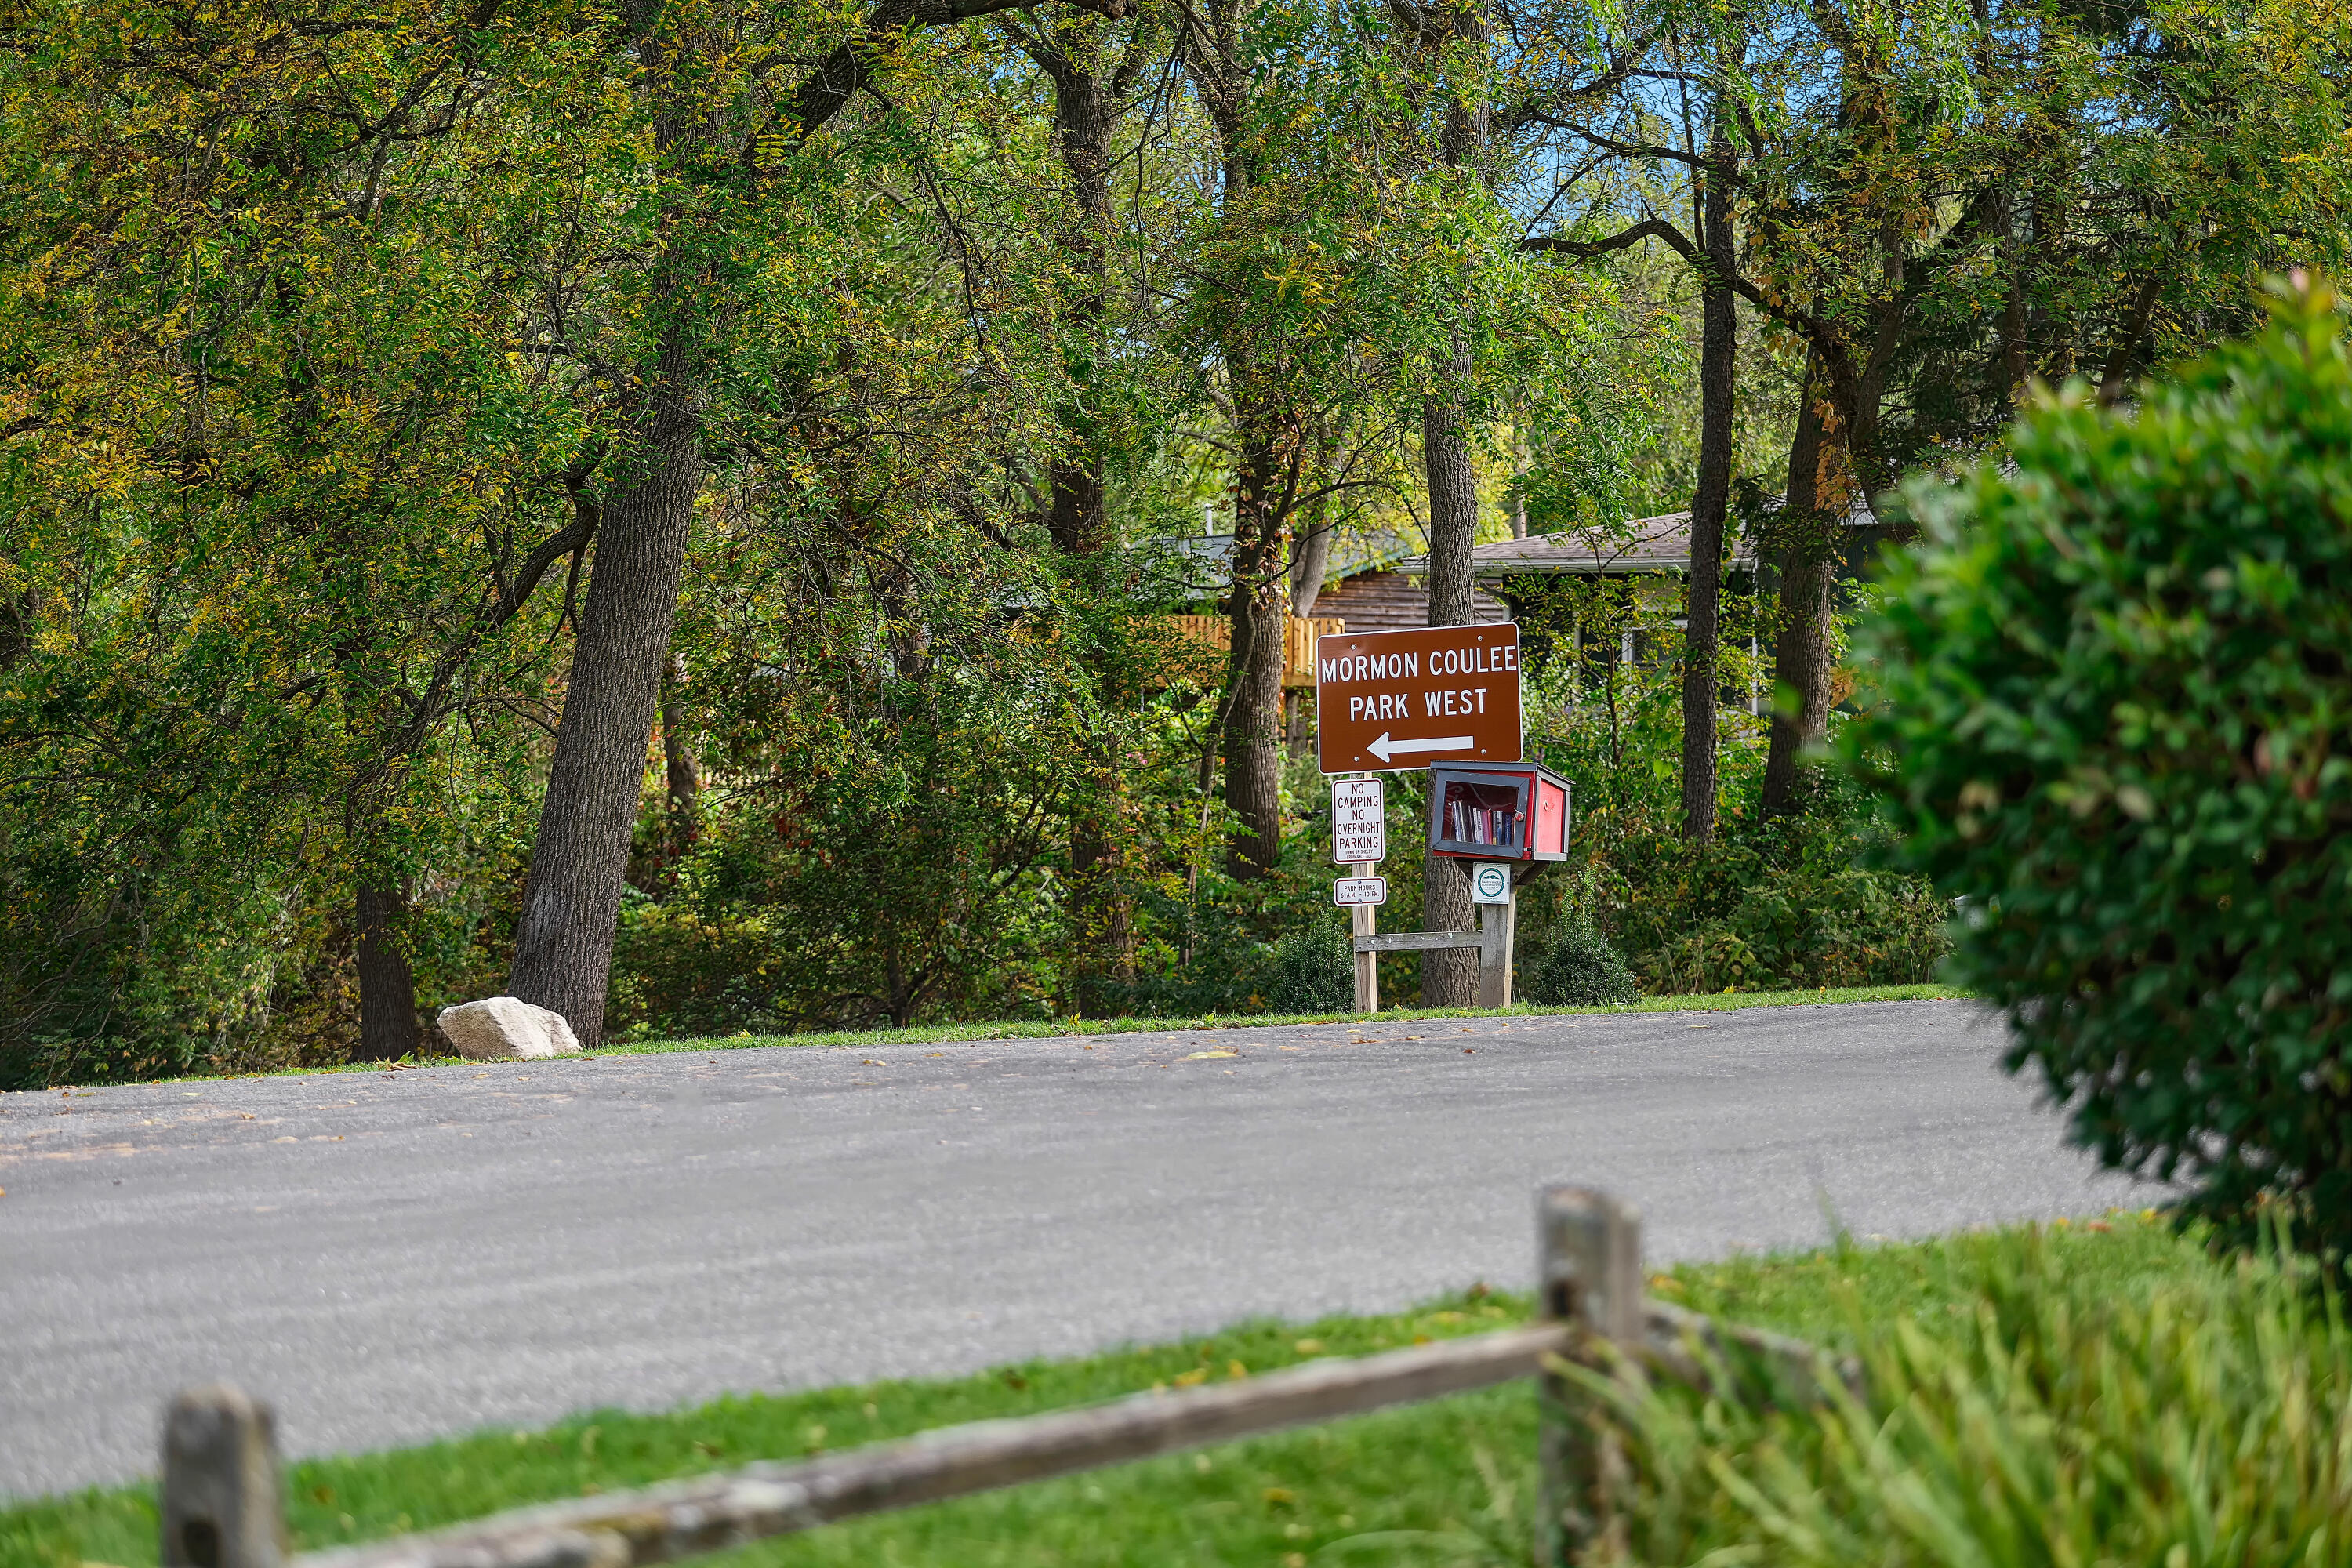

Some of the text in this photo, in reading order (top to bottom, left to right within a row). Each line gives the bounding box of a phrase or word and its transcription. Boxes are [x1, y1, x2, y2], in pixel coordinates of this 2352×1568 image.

[1321, 645, 1518, 684] MORMON COULEE
[1349, 688, 1487, 722] PARK WEST
[1352, 783, 1364, 794] NO
[1338, 795, 1378, 808] CAMPING
[1352, 809, 1364, 820] NO
[1338, 822, 1380, 835] OVERNIGHT
[1339, 836, 1378, 849] PARKING
